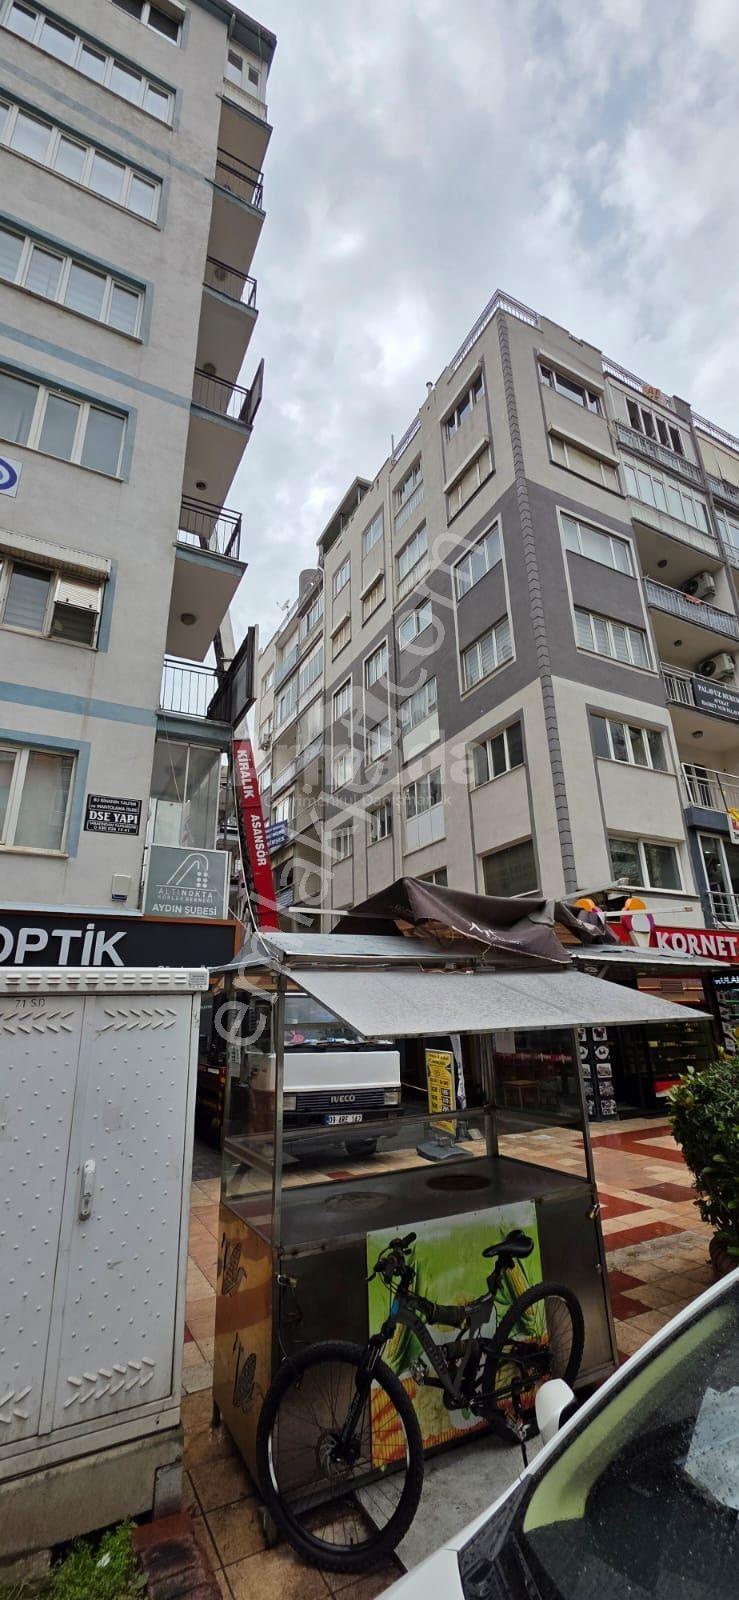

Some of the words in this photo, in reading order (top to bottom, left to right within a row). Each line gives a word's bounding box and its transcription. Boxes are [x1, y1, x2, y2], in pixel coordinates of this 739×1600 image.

[237, 750, 255, 798] KİRALIK
[89, 810, 111, 821] DSE
[113, 813, 138, 824] YAPI
[250, 814, 269, 866] ASANSÖR
[151, 904, 182, 913] AYDIN
[656, 931, 738, 957] KORNET
[15, 999, 26, 1008] 71
[330, 1095, 356, 1104] IVECO
